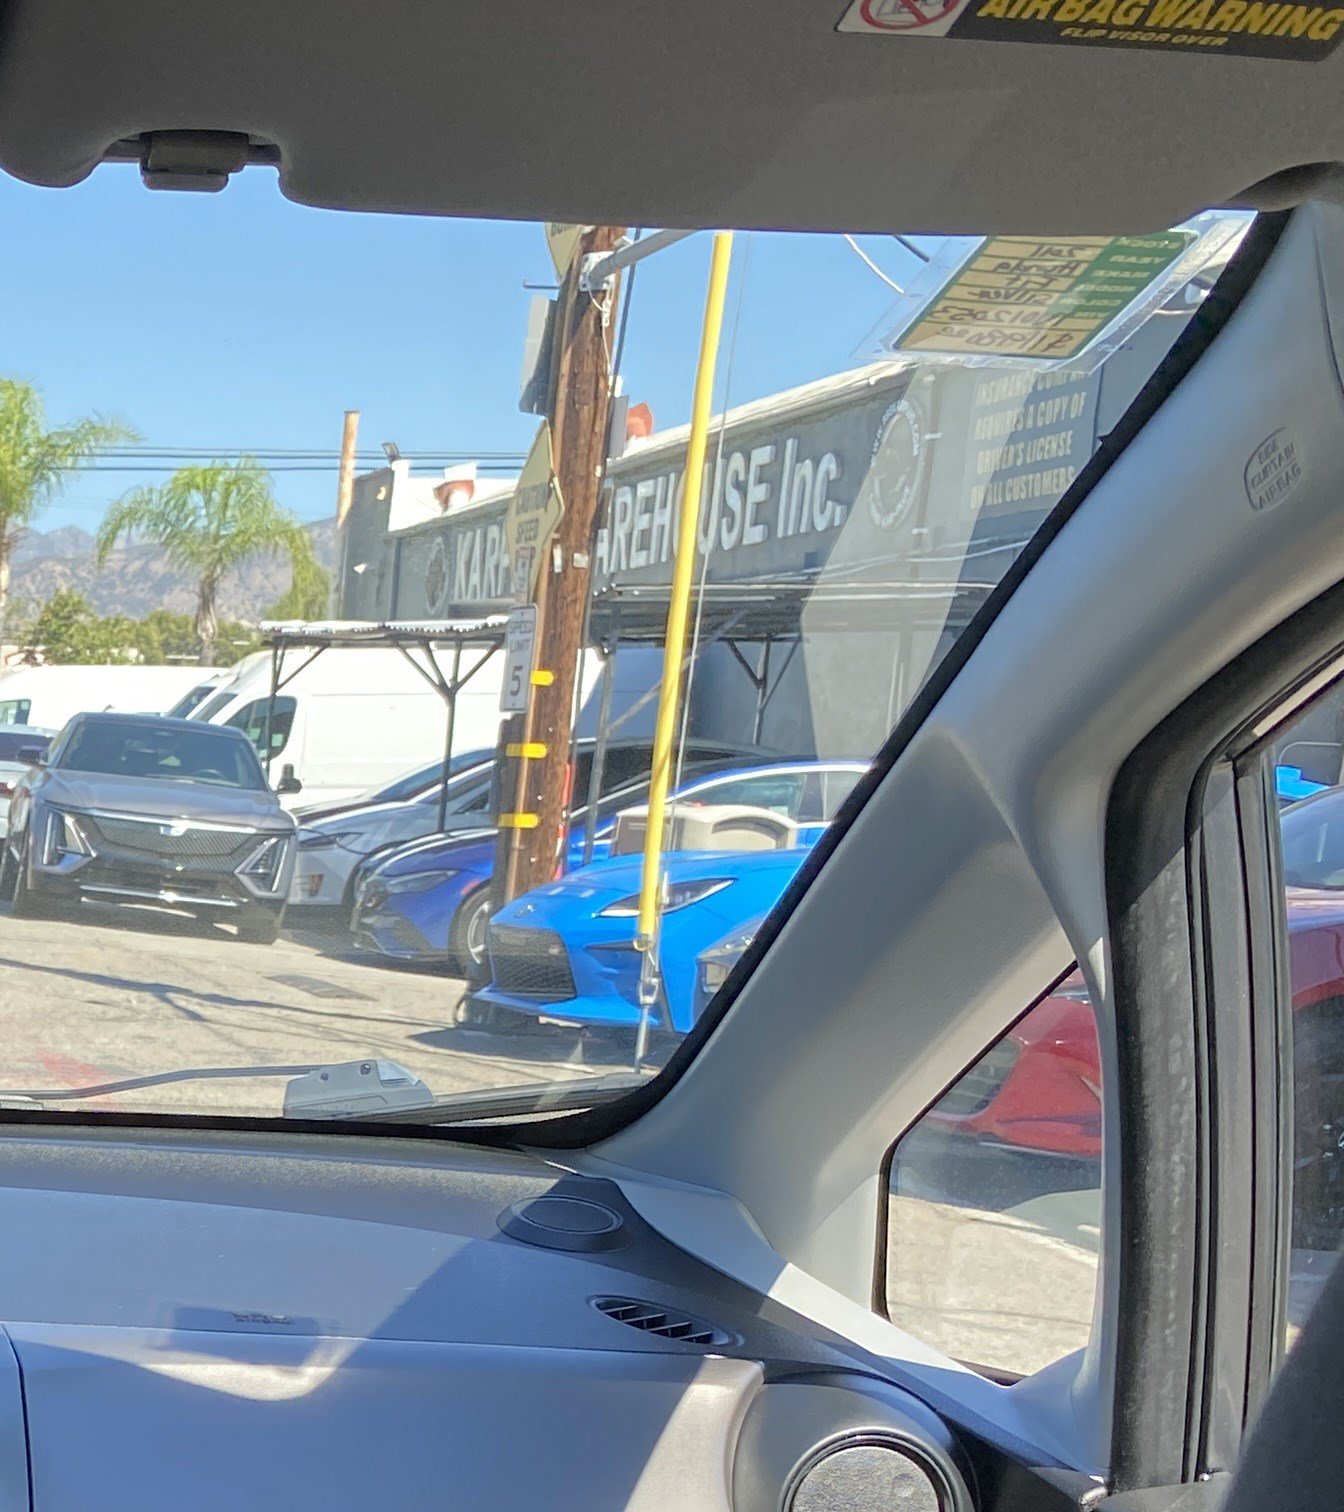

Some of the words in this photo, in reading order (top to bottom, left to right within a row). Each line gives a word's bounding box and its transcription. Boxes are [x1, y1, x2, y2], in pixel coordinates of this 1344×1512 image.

[1145, 0, 1343, 40] WARNING
[1171, 34, 1229, 46] OVER
[1037, 397, 1069, 427] COPY
[1070, 391, 1087, 418] OF
[1026, 430, 1074, 463] LICENSE
[985, 478, 1003, 506] ALL
[1005, 466, 1075, 502] CUSTOMERS
[594, 445, 776, 577] AREHUSE
[777, 437, 847, 538] Inc.
[510, 664, 524, 697] 5
